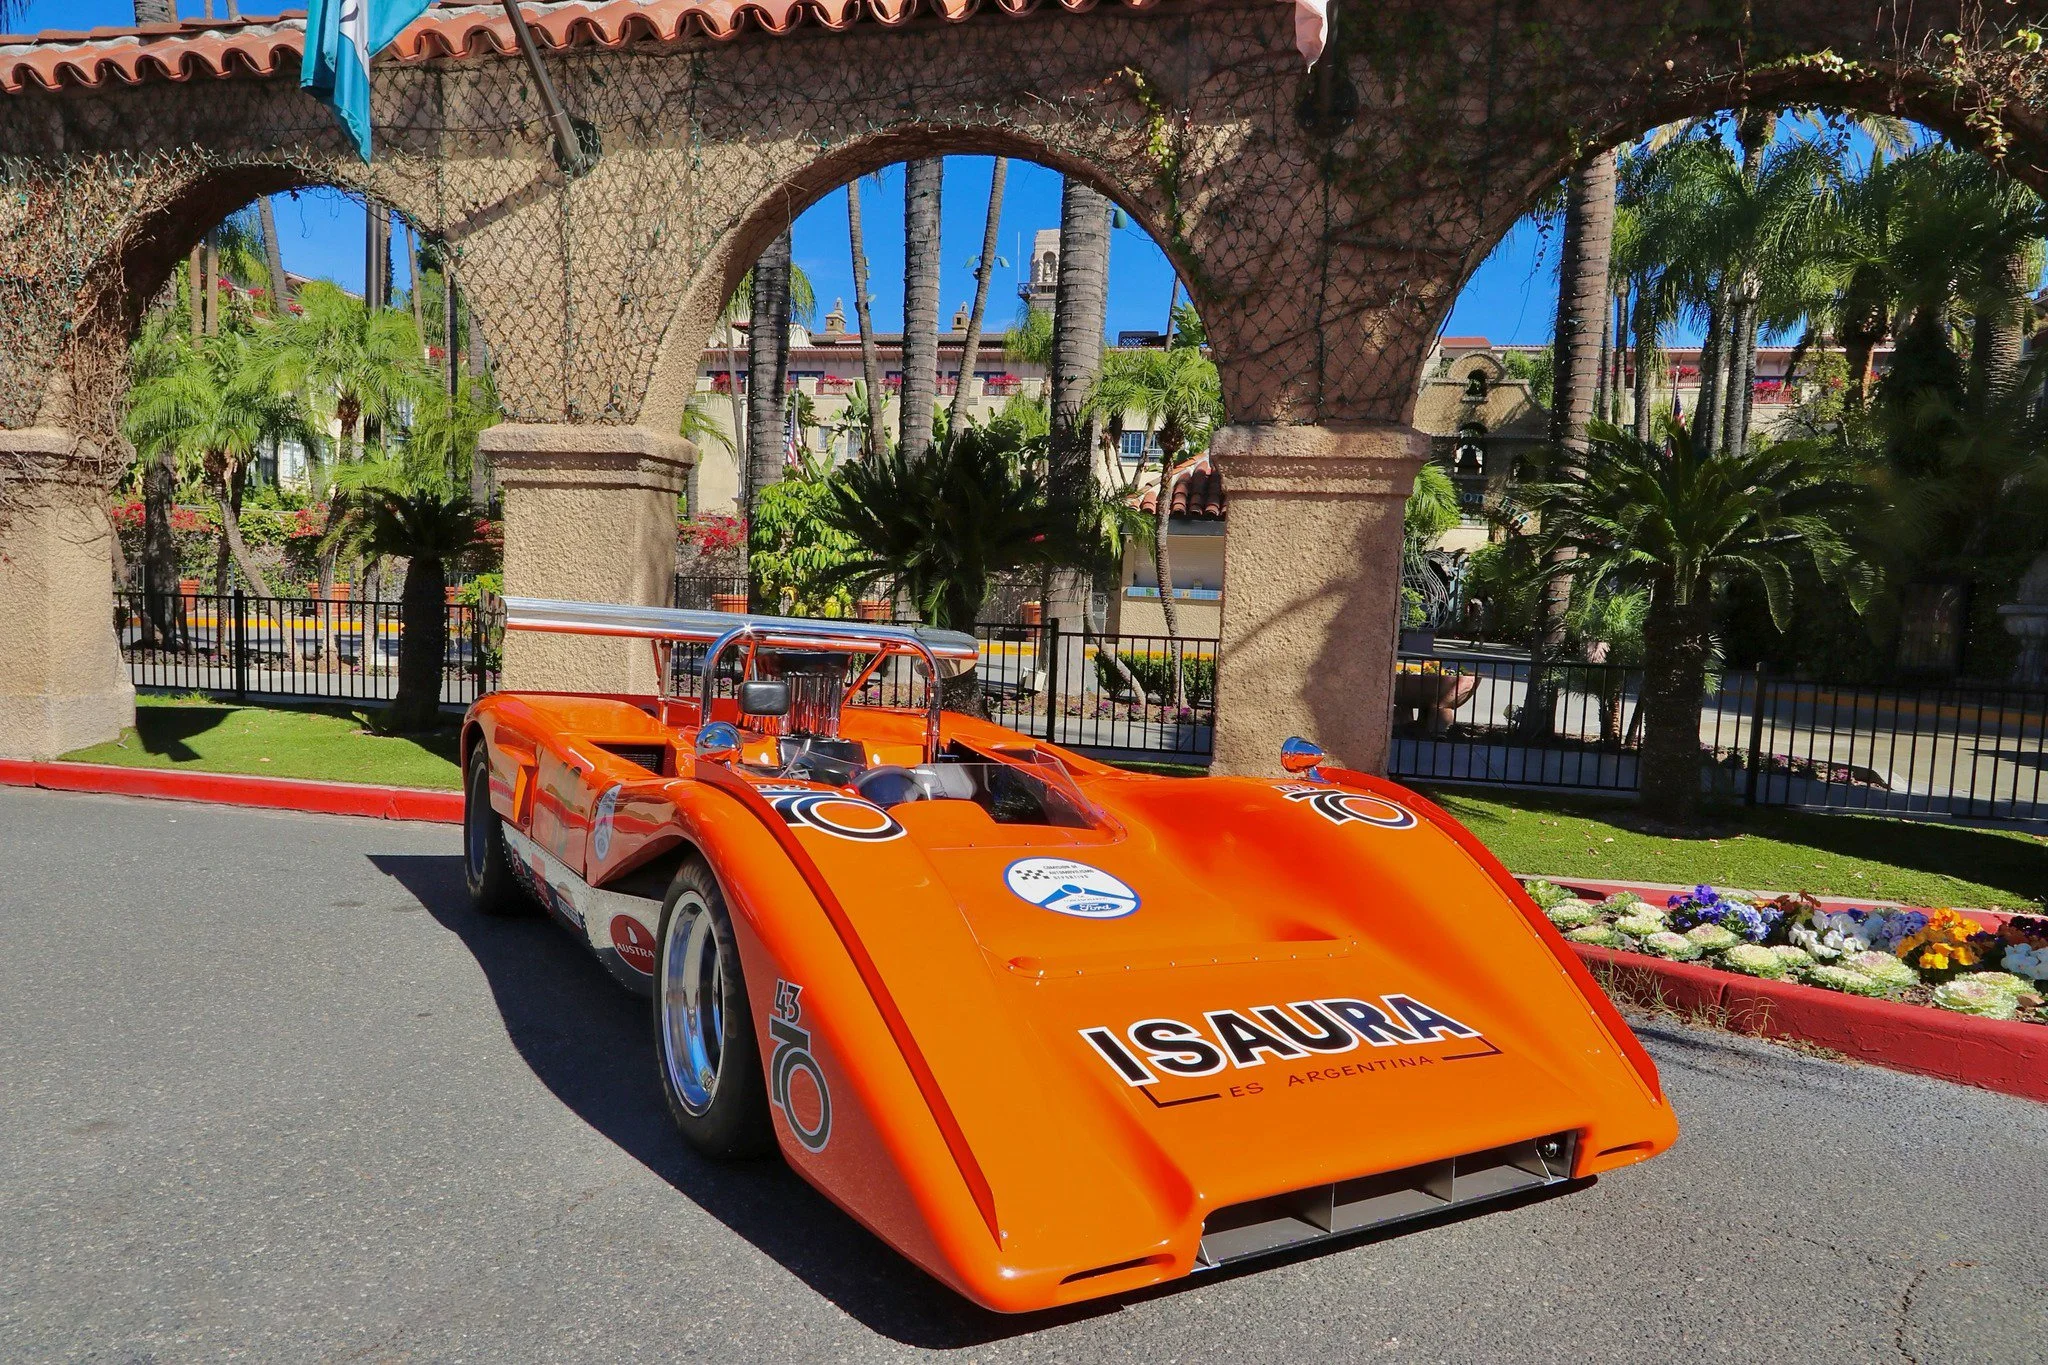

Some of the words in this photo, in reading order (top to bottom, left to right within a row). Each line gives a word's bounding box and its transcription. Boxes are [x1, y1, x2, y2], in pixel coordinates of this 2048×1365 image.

[1282, 789, 1418, 830] 70
[1079, 902, 1112, 912] Ford
[775, 978, 803, 1026] 43
[1078, 993, 1484, 1087] ISAURA
[769, 1014, 833, 1154] 70
[1229, 1082, 1264, 1098] ES
[1287, 1055, 1434, 1087] ARGENTINA
